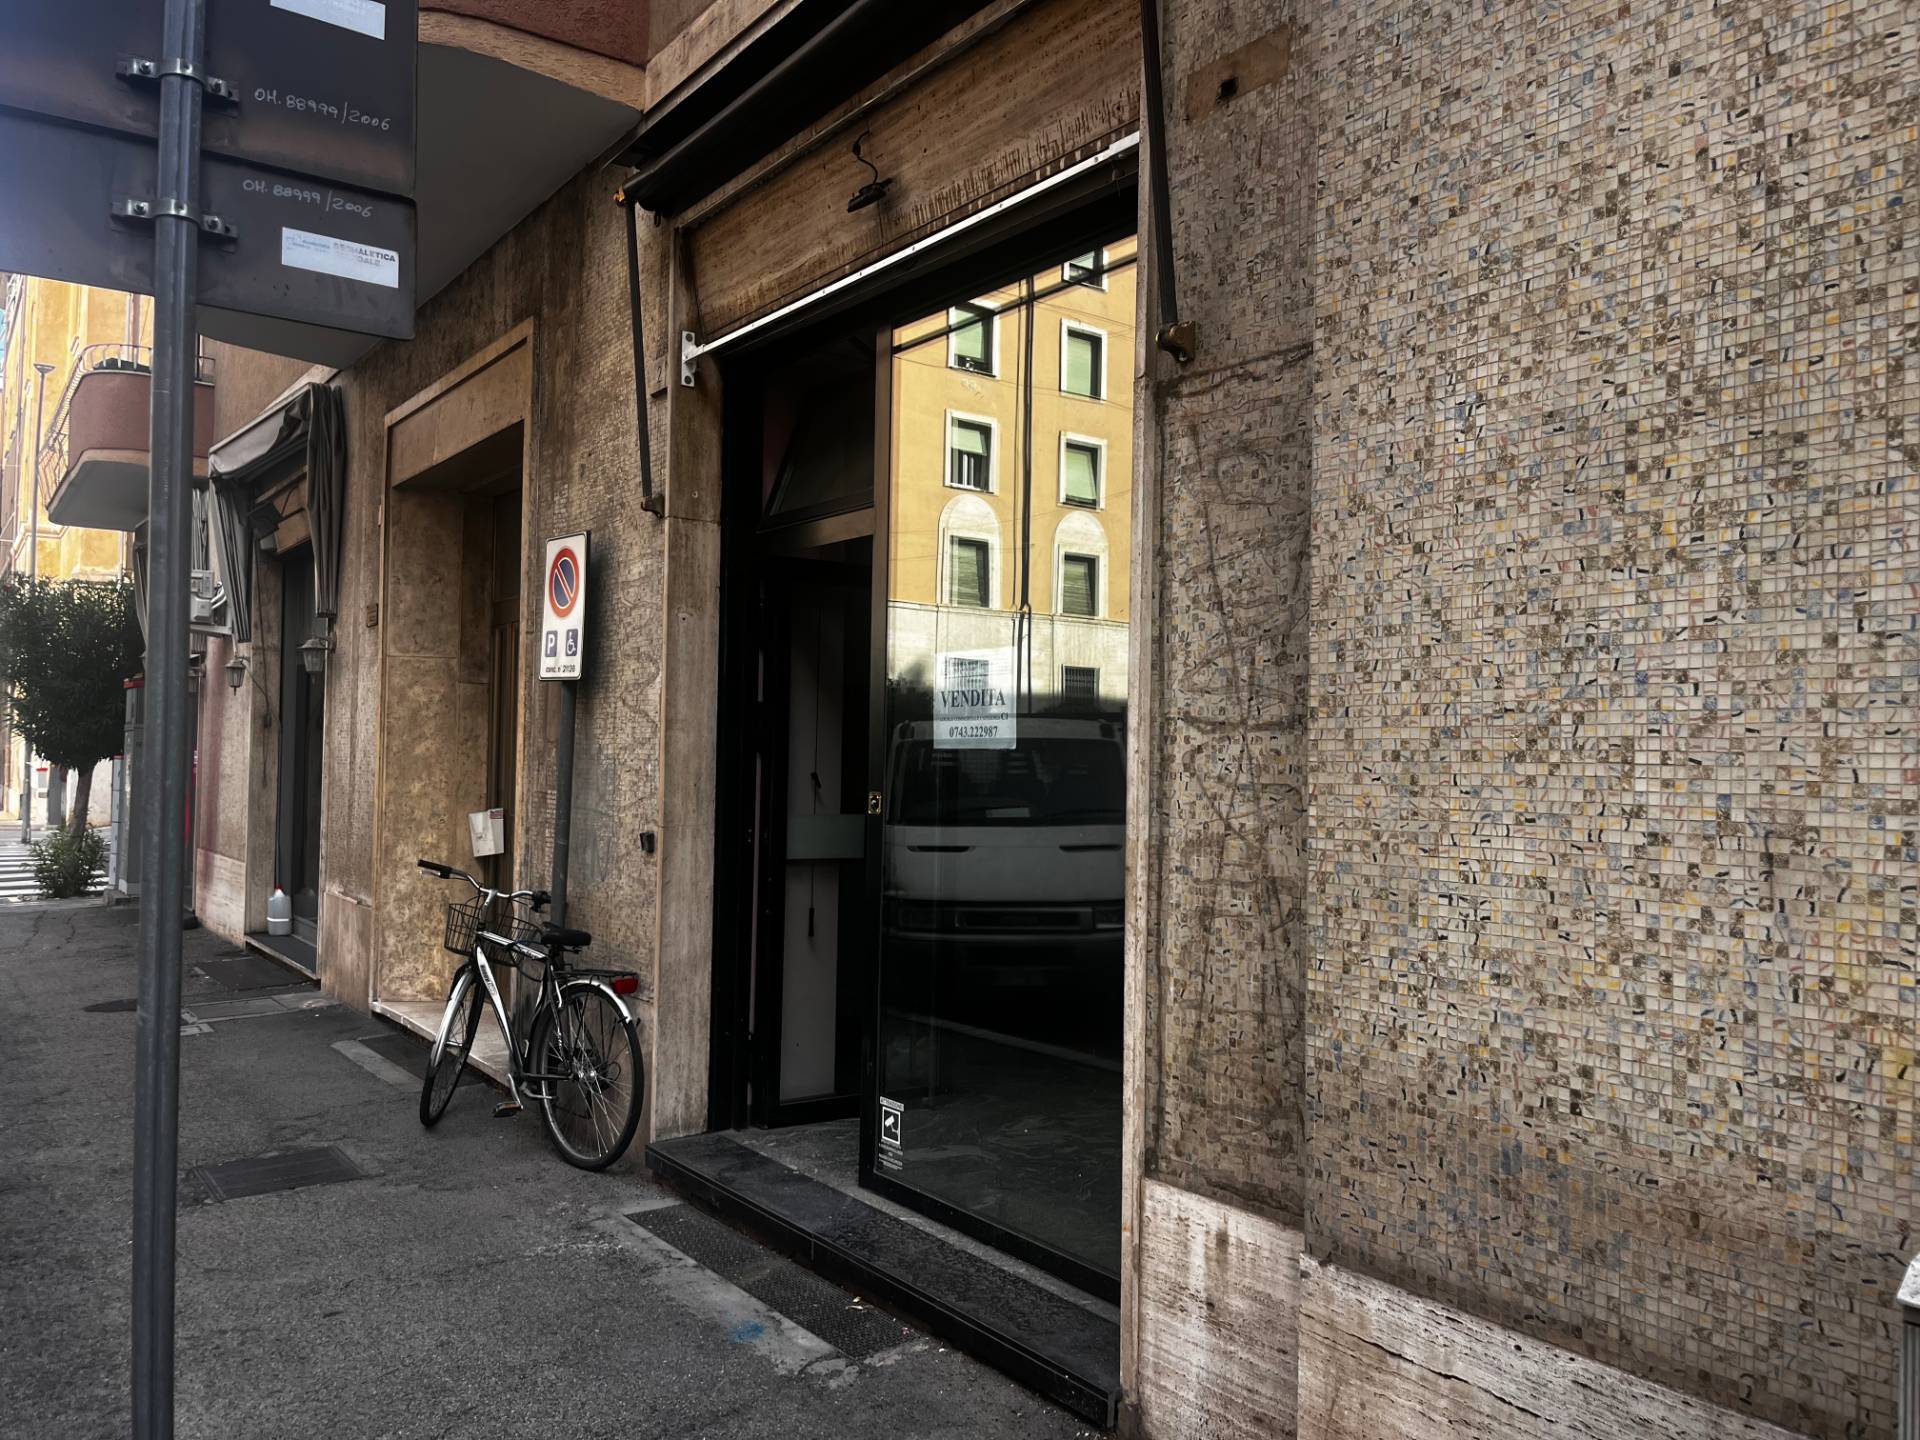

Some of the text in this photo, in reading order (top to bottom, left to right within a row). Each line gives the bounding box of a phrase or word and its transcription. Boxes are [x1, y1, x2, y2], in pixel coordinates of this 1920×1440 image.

[286, 94, 391, 131] 88999/2006
[273, 184, 372, 217] 88999/2006
[547, 633, 555, 655] P
[941, 688, 1006, 708] VENDITA
[949, 726, 998, 738] 0743.222987
